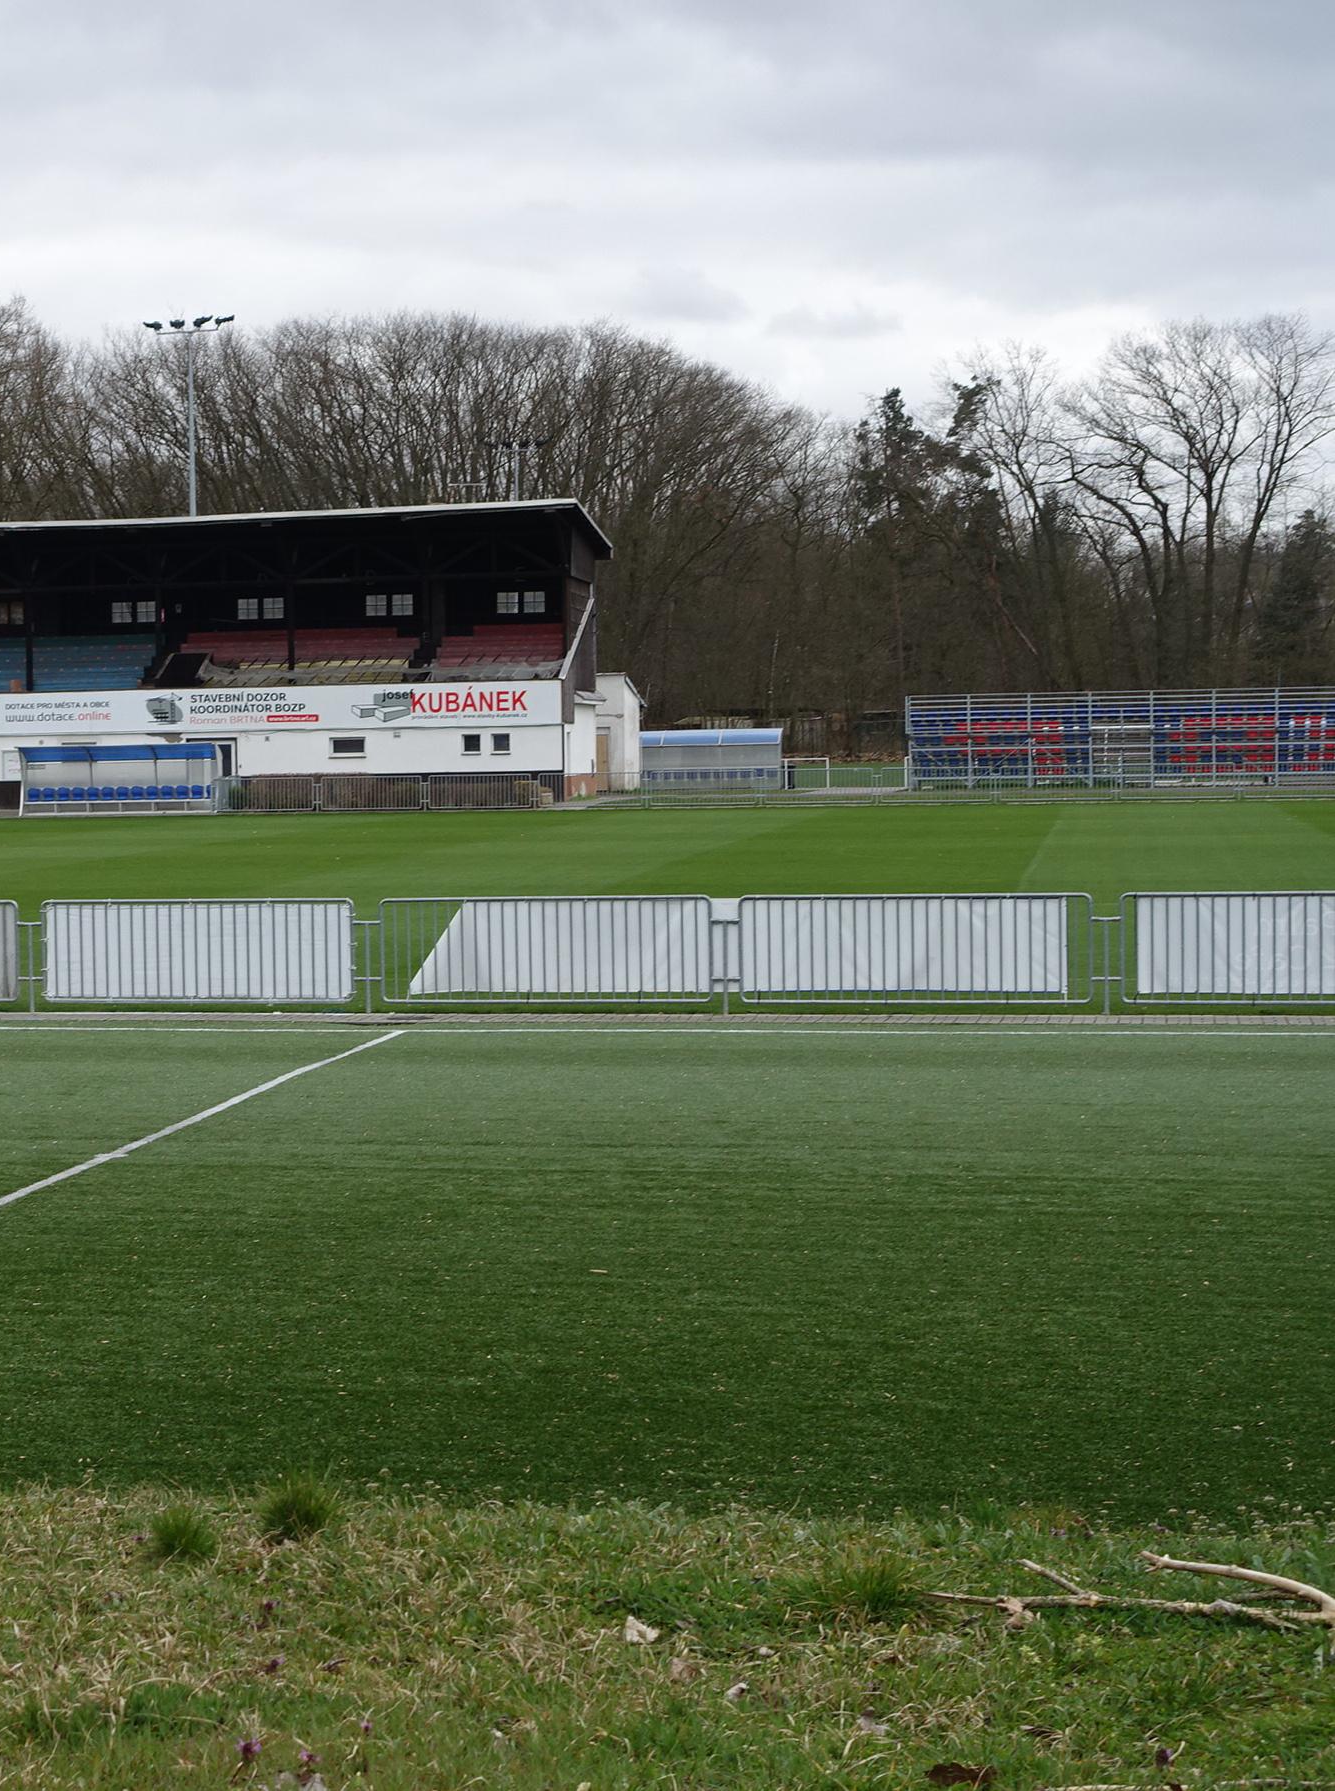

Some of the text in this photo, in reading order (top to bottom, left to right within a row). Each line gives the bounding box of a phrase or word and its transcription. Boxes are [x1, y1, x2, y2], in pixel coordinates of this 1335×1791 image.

[190, 691, 287, 703] STAVEBNÍ DOZOR
[382, 688, 414, 703] josef
[411, 685, 529, 713] KUBÁNEK
[54, 701, 80, 709] MĚSTA
[189, 702, 306, 714] KOORDINÁTOR BOZP
[5, 711, 112, 722] www.dotace.online
[189, 715, 227, 725] Roman
[229, 714, 266, 724] BRTNA
